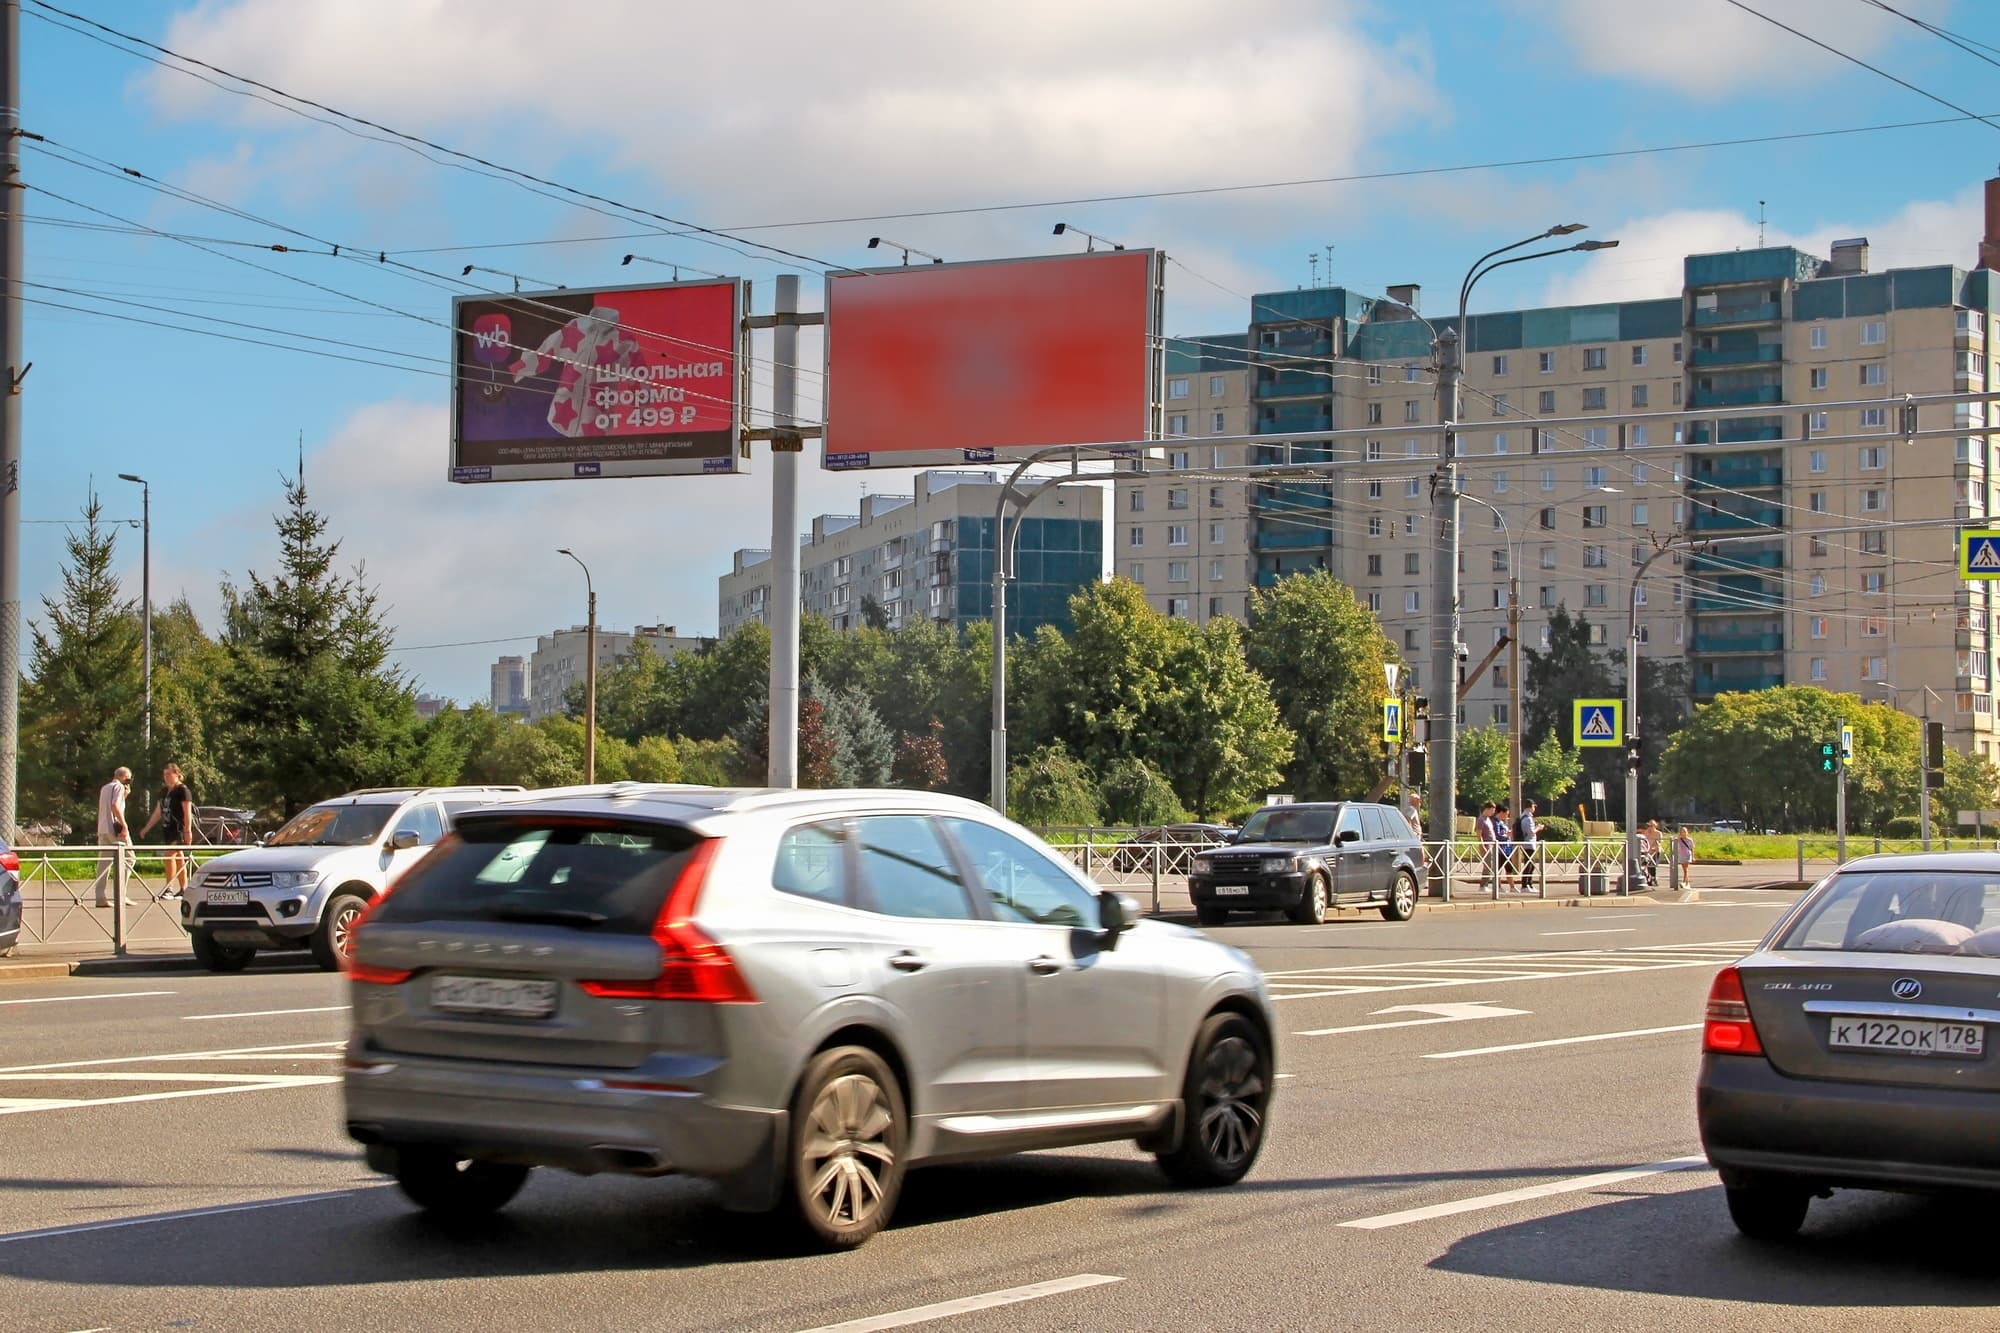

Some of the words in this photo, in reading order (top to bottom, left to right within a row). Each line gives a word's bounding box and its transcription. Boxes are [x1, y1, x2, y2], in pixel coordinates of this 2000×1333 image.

[476, 324, 509, 349] wb
[596, 362, 723, 383] Школьная
[595, 386, 685, 409] форма
[595, 413, 622, 429] от
[626, 406, 675, 427] 499
[1940, 1026, 1976, 1045] 178
